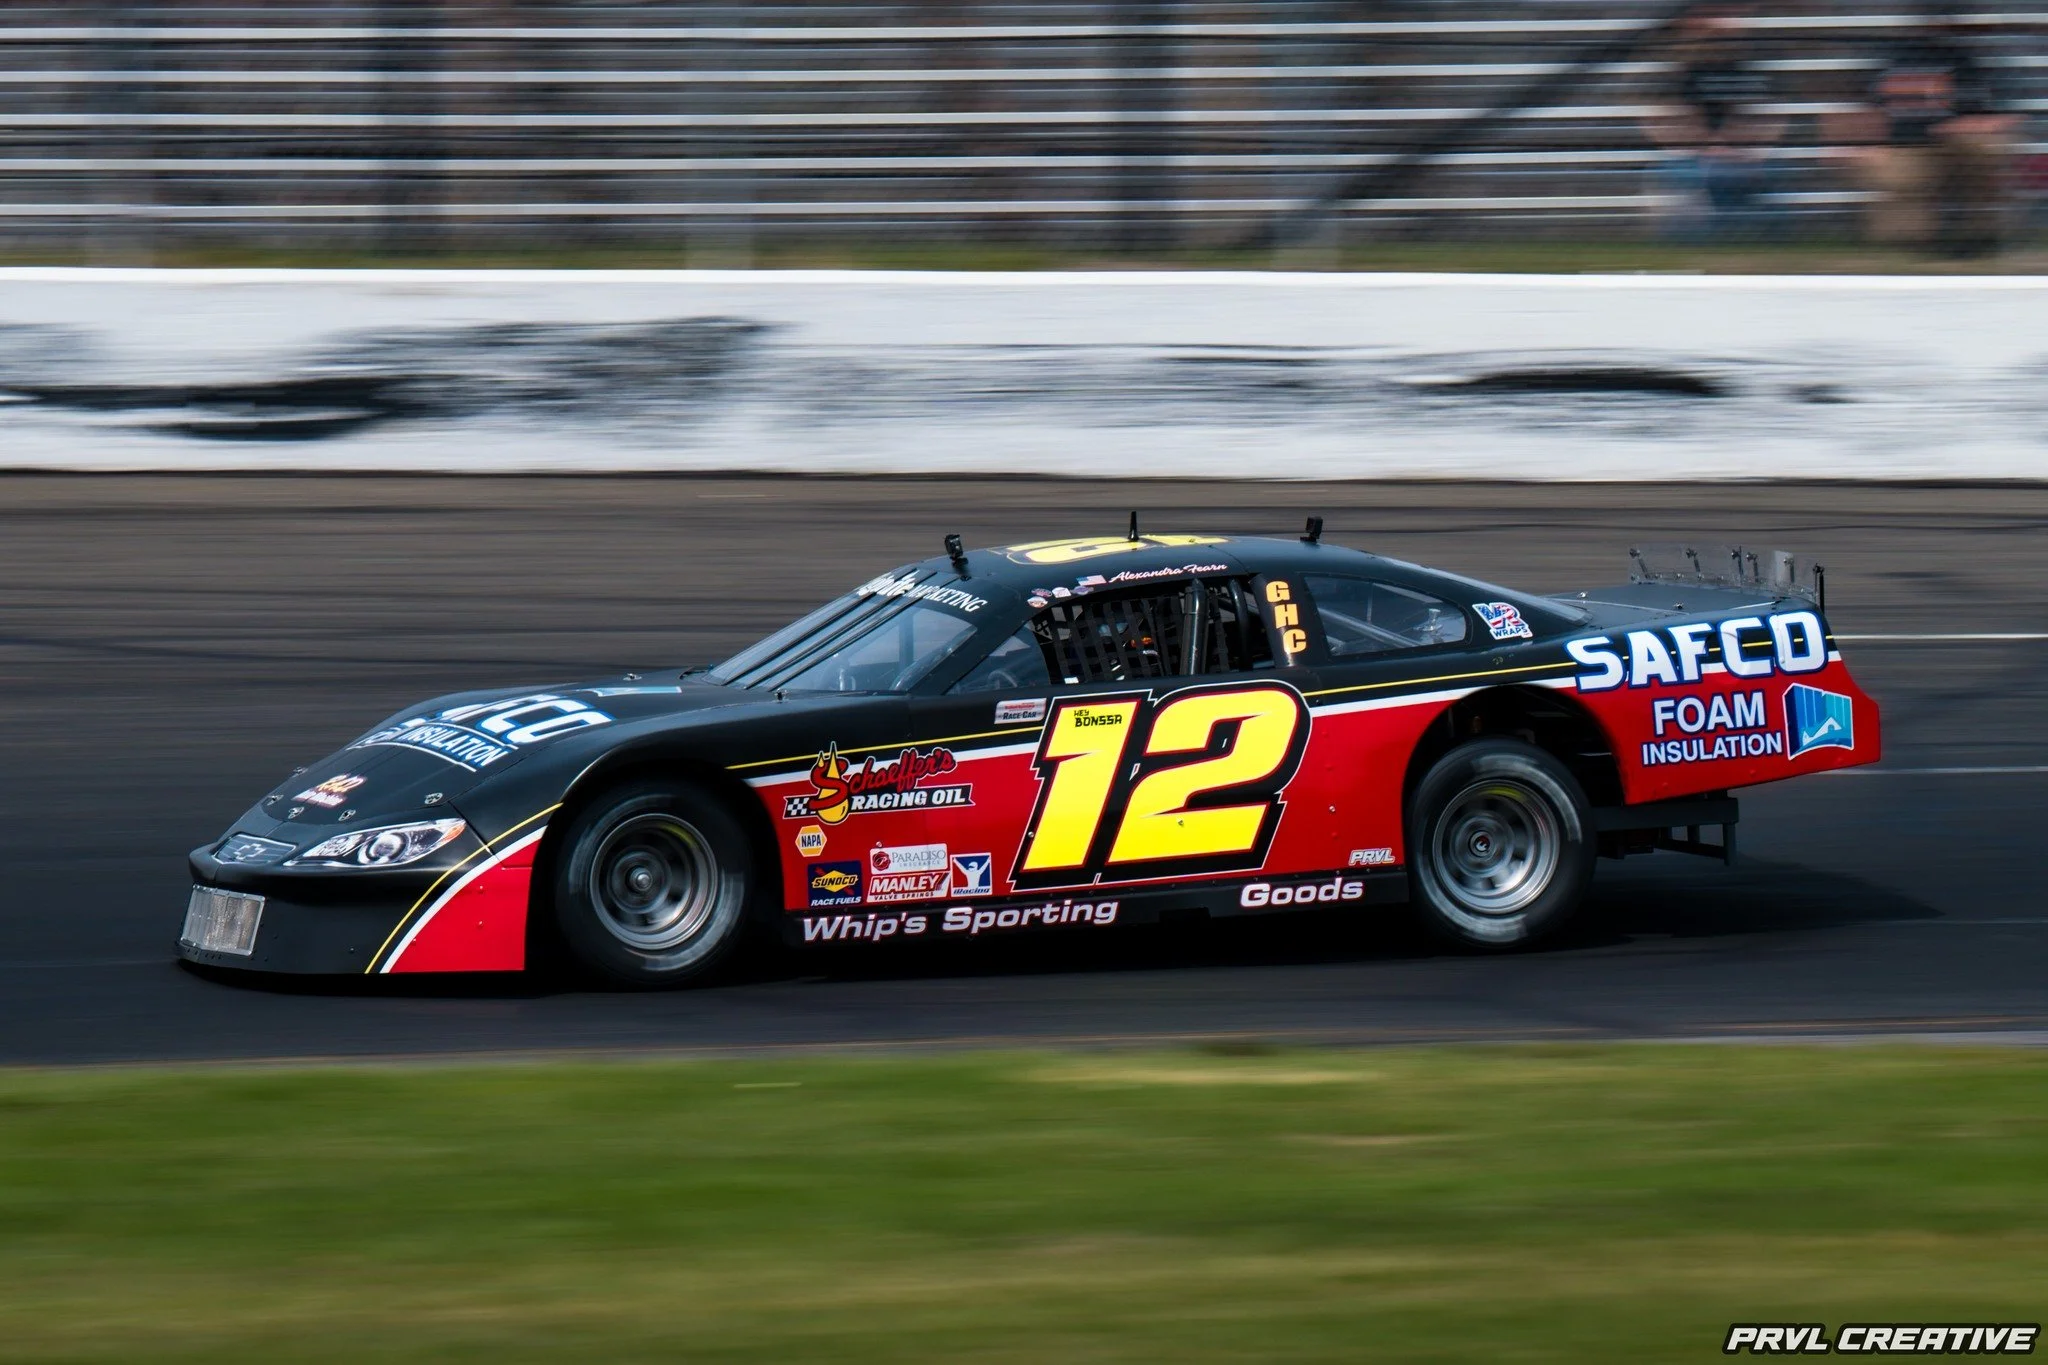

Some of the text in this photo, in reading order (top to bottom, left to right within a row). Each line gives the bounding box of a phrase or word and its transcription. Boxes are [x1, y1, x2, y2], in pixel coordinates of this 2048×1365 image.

[1108, 563, 1228, 583] Alexandra Fearn
[1494, 626, 1528, 637] WRAPS
[1565, 610, 1828, 690] SAFCO
[1003, 711, 1037, 720] RACE CAR
[1074, 709, 1090, 717] HEY
[1653, 691, 1766, 735] FOAM
[1642, 731, 1782, 765] INSULATION
[808, 746, 957, 811] Schaeffer's
[1014, 684, 1304, 876] 12
[850, 788, 965, 811] RACING OIL
[801, 834, 822, 848] NAPA
[892, 849, 946, 864] PARADISO
[1350, 849, 1394, 864] PRVL
[813, 874, 858, 888] SUNOCO
[871, 874, 940, 893] MANLEY
[810, 896, 862, 906] RACE FUELS
[901, 891, 934, 899] SPRINGS
[803, 877, 1364, 941] Whip's Sporting Goods
